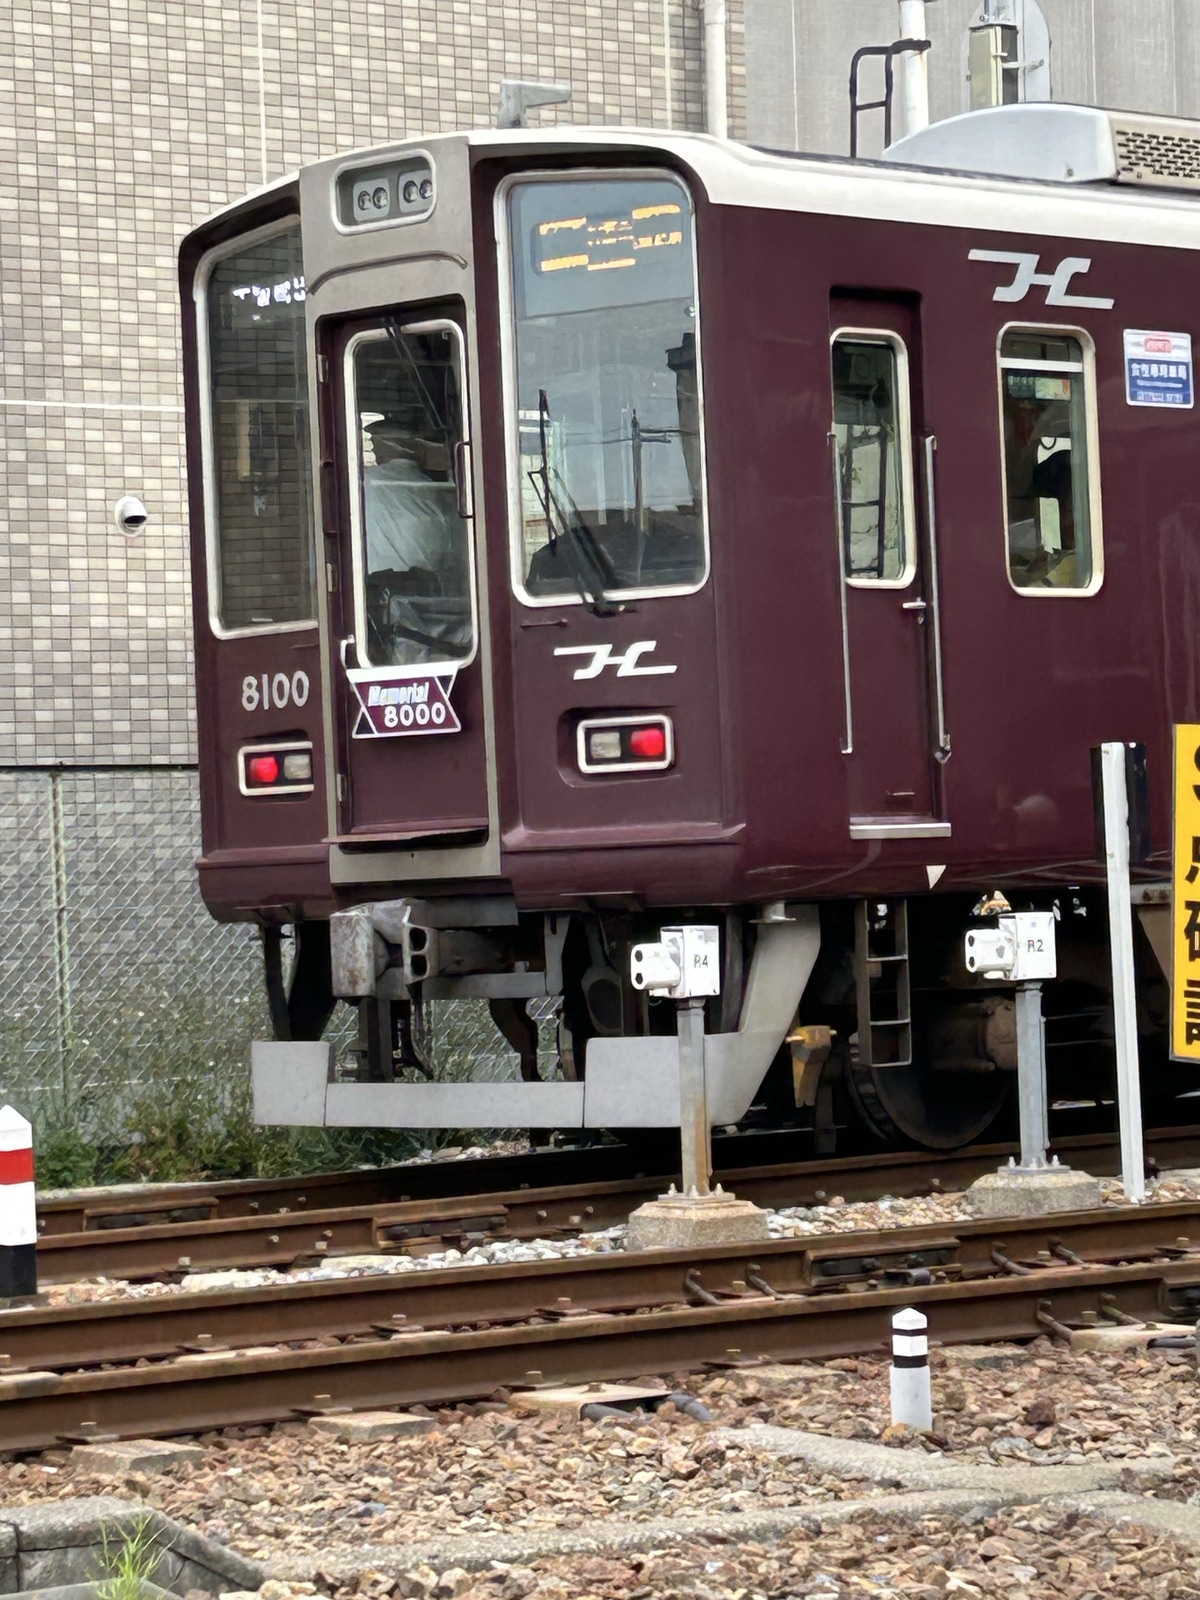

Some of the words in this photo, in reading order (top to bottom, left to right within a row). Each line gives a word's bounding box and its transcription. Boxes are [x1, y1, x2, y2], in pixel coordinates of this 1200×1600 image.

[241, 670, 310, 712] 8100
[383, 701, 447, 728] 8000
[1027, 939, 1044, 953] R2
[694, 954, 708, 969] R4
